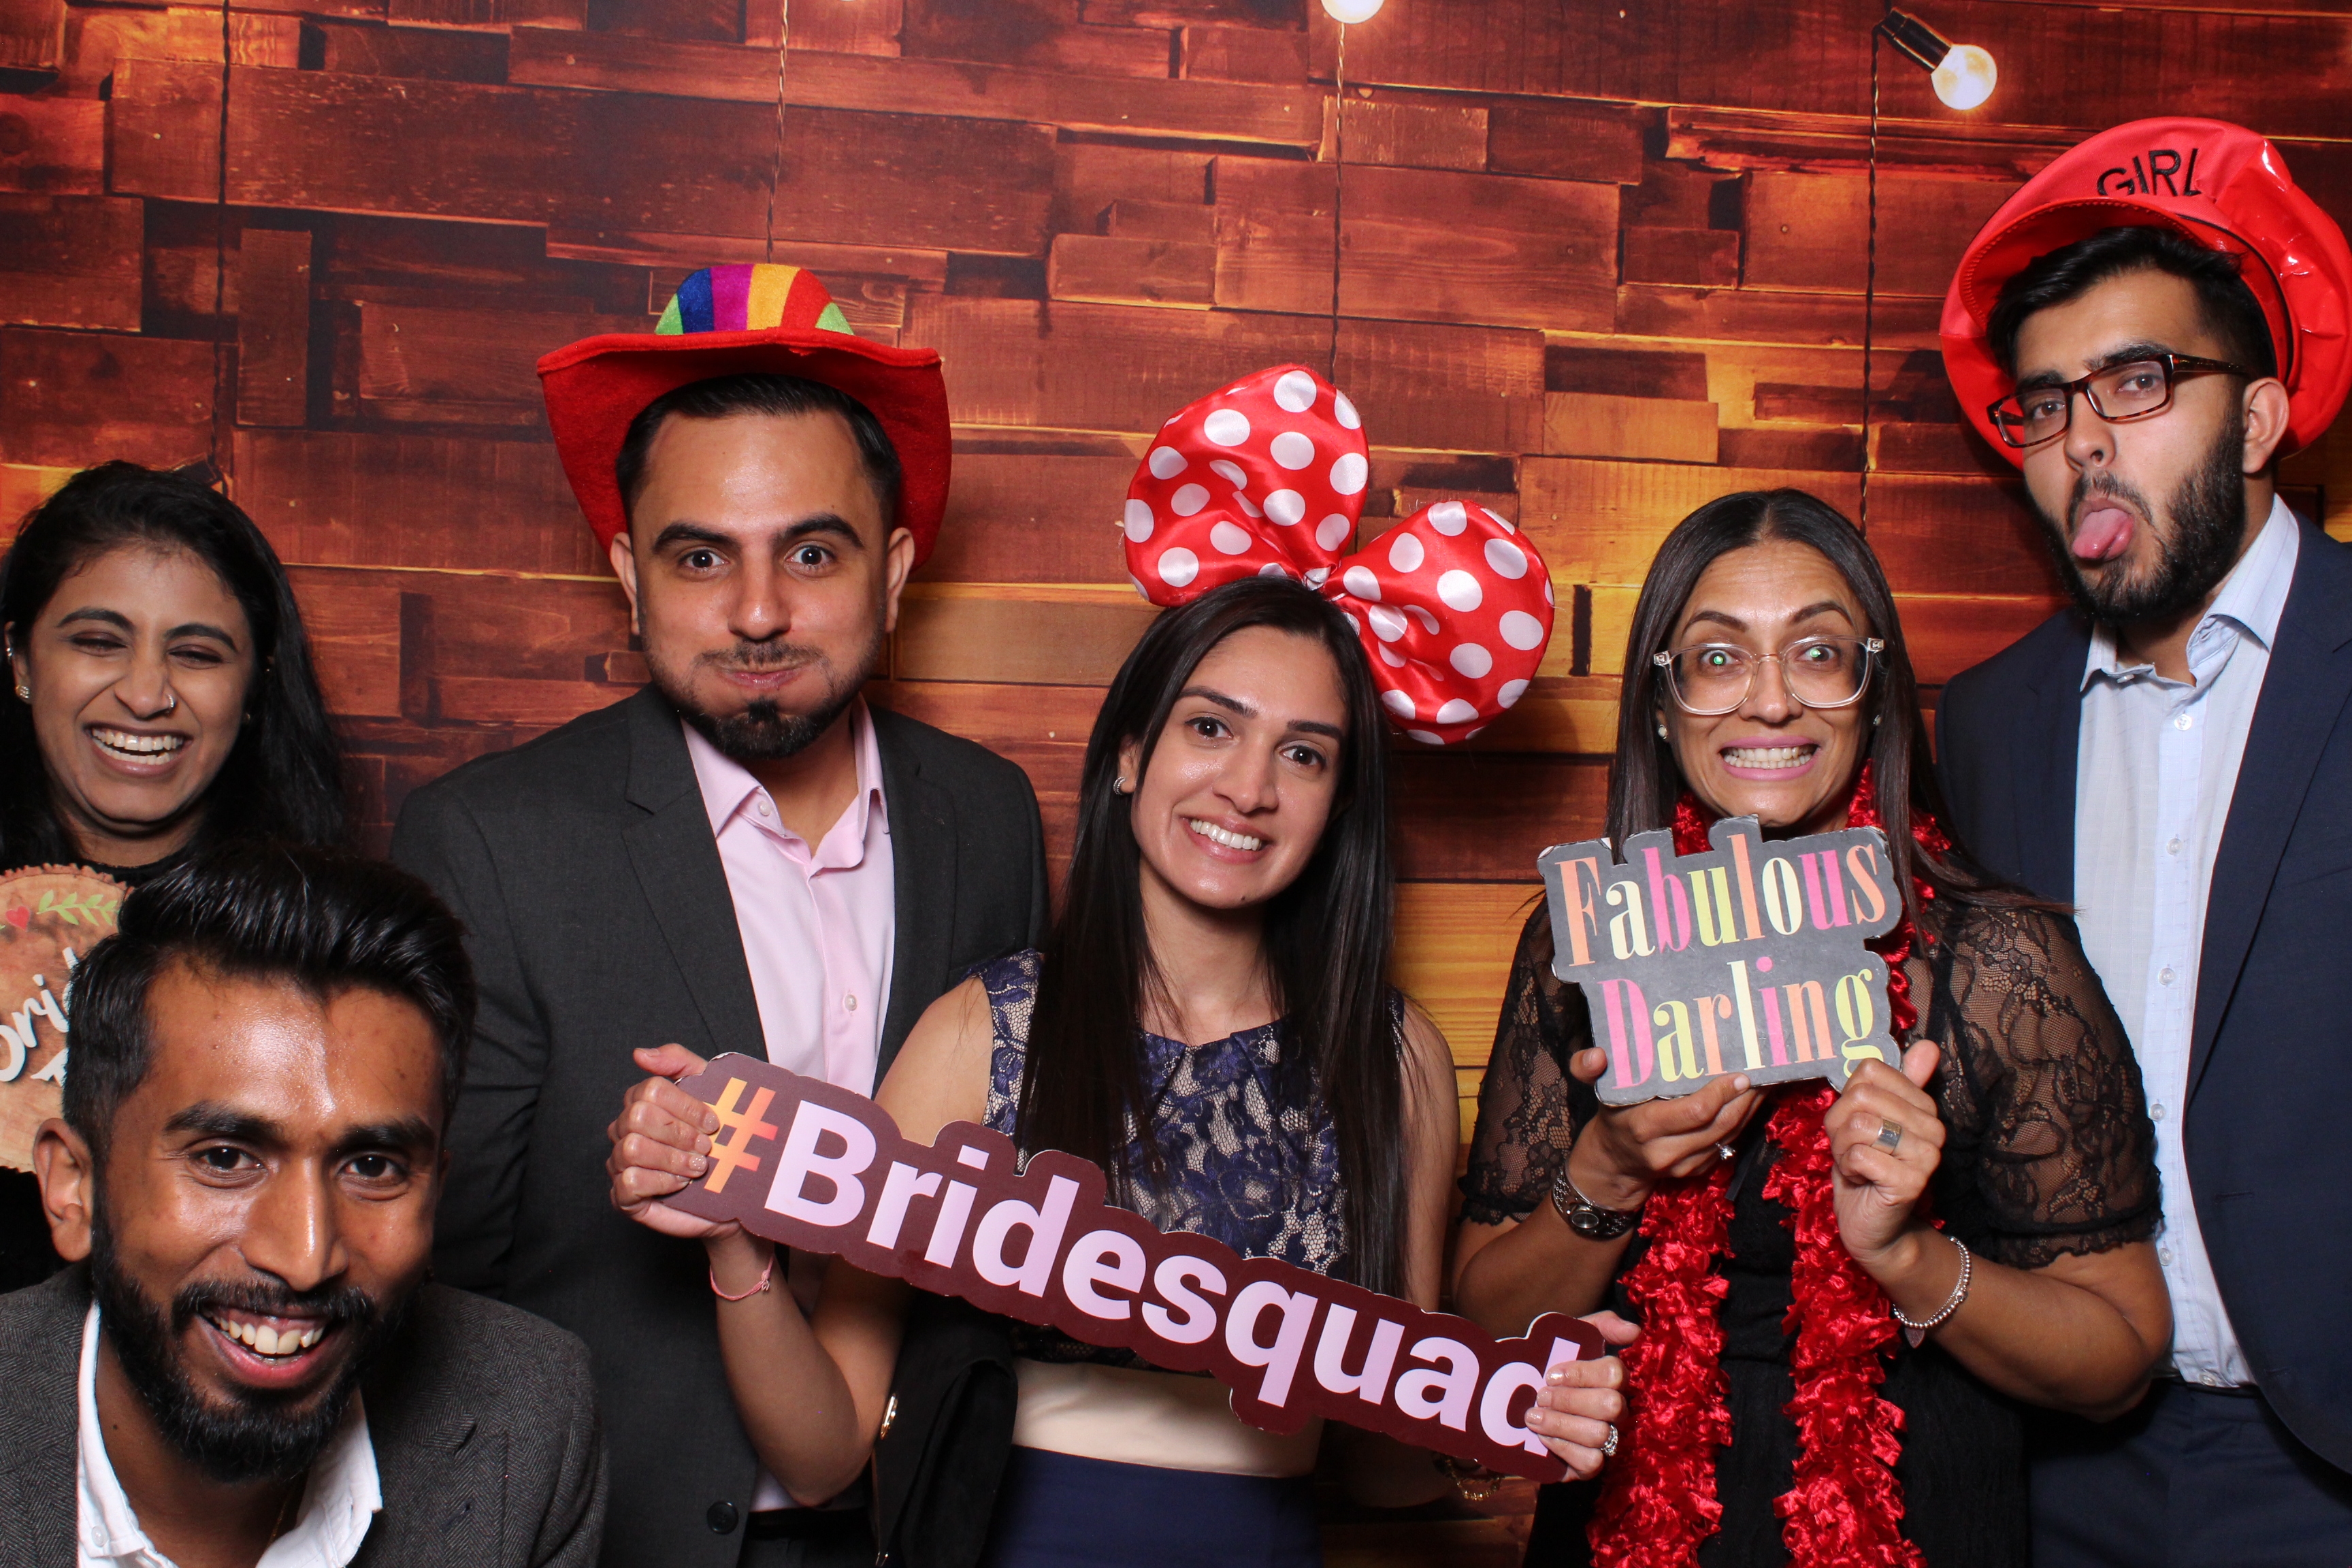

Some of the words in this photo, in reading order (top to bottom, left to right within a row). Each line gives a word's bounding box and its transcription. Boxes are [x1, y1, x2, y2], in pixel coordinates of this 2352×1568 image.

[2097, 148, 2202, 197] GIRL
[1554, 833, 1886, 966] Fabulous
[1597, 956, 1884, 1090] Darling
[702, 1076, 1581, 1458] #Bridesquad
